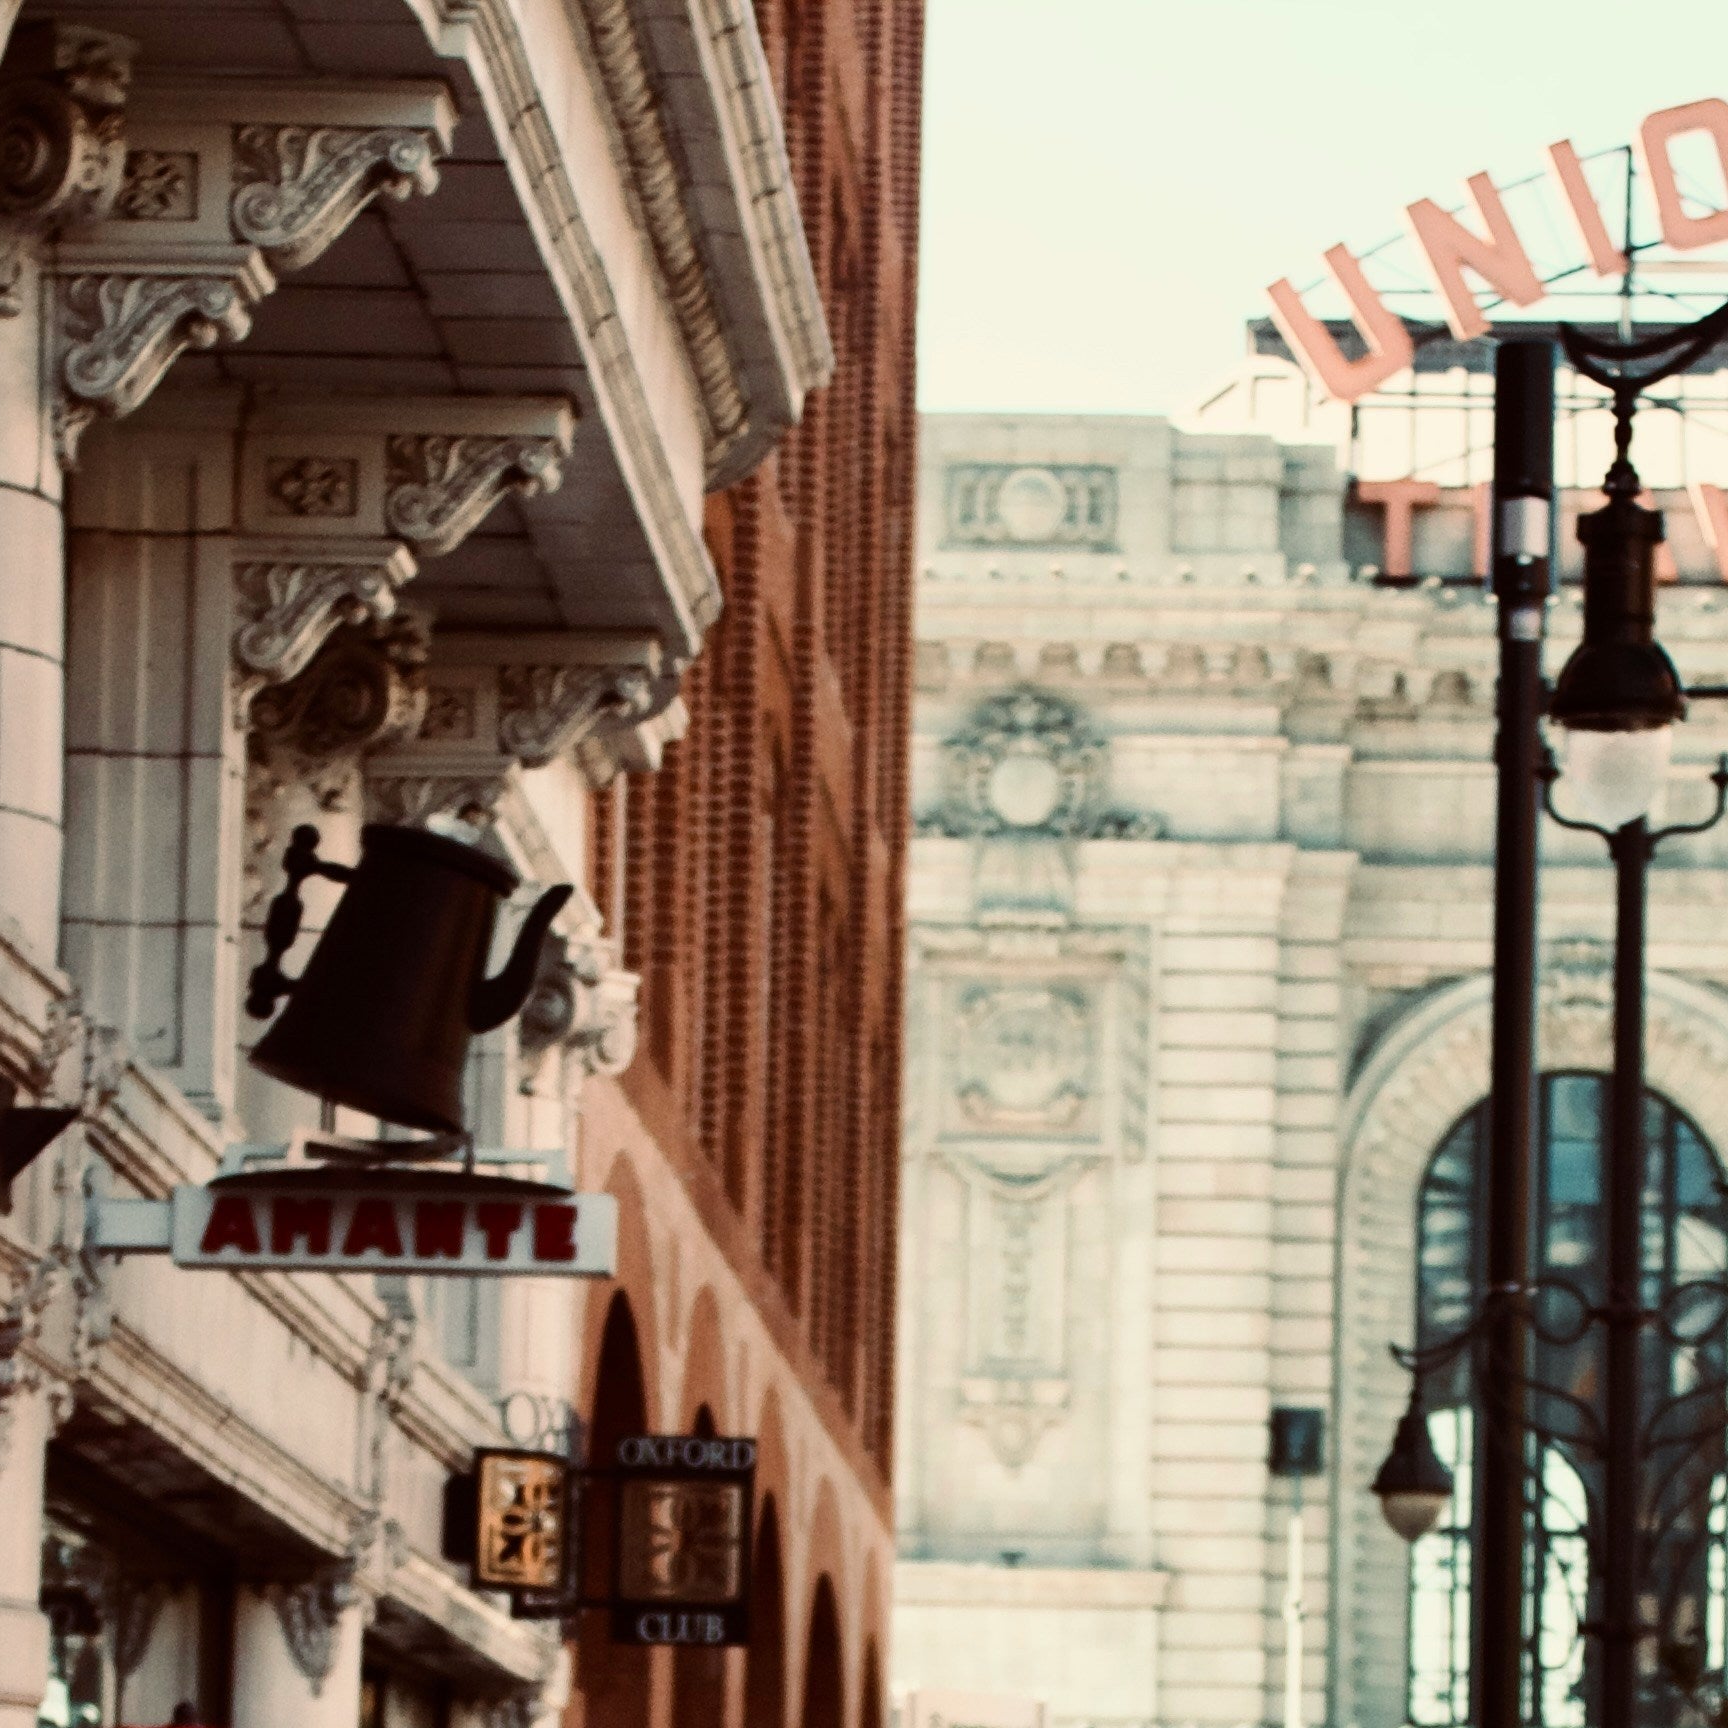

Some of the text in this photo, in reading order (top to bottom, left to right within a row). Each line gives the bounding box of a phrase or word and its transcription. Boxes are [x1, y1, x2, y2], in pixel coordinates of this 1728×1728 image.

[200, 1198, 578, 1262] AMANTE
[619, 1437, 756, 1468] OXFORD
[636, 1612, 725, 1642] CLUB
